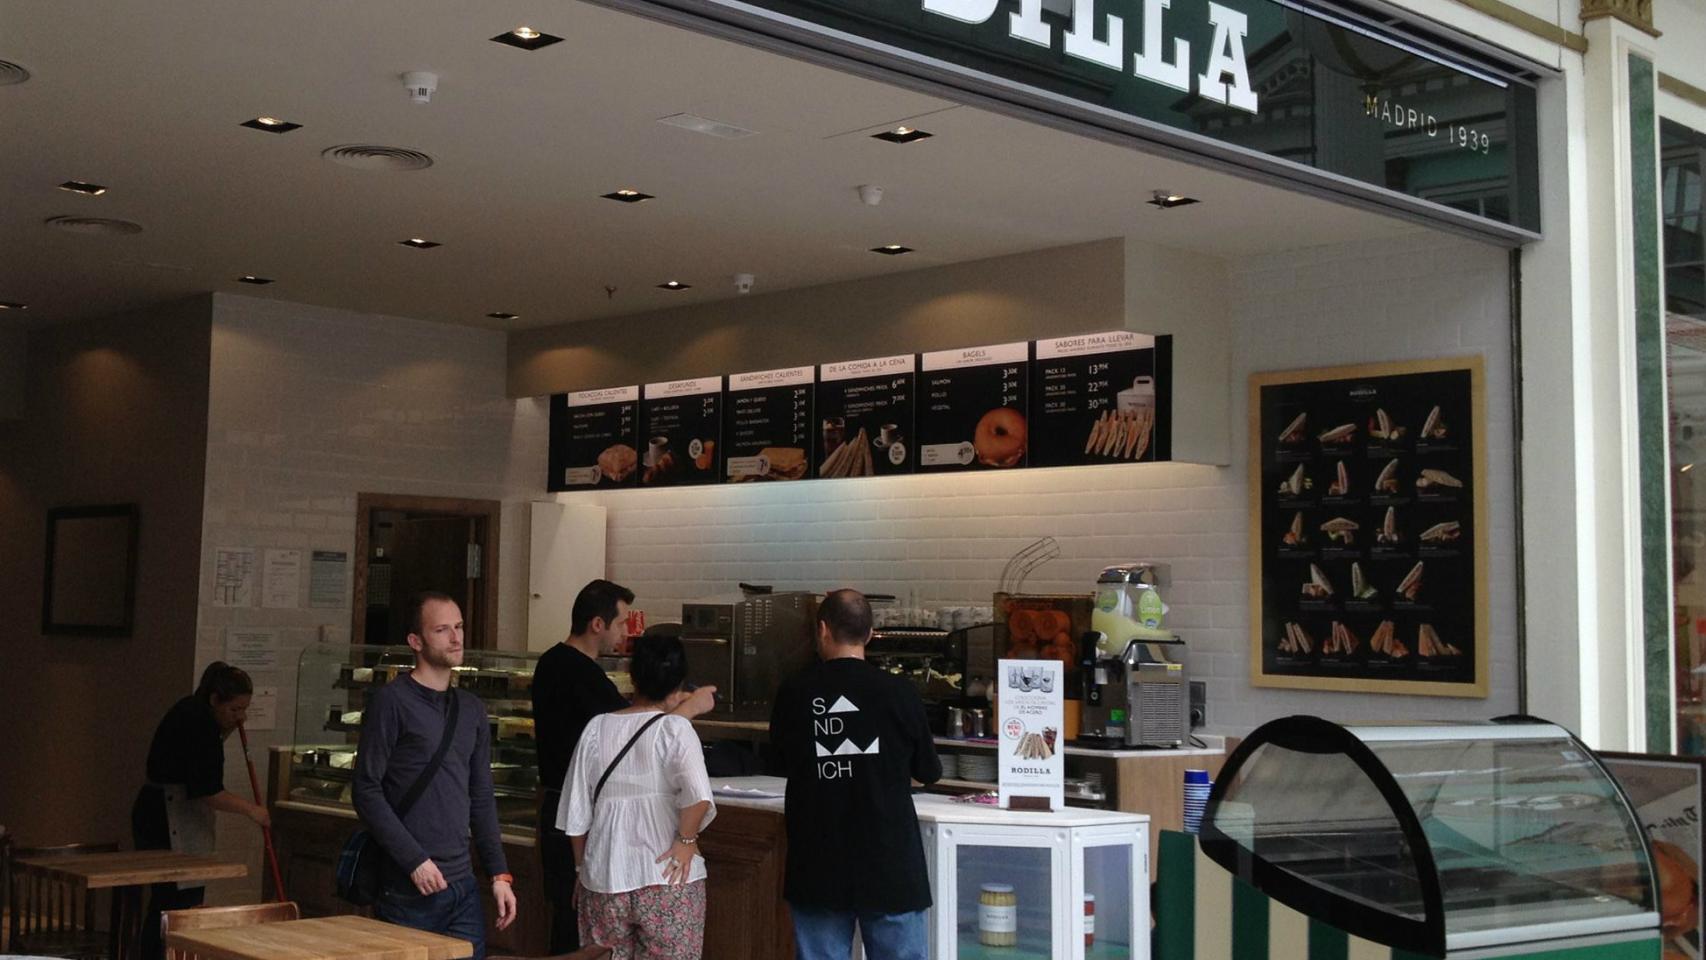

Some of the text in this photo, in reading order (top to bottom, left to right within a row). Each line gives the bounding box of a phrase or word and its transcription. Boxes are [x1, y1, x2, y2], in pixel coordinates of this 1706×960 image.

[1366, 94, 1489, 155] MADRID 1939
[1088, 337, 1105, 345] PARA
[1109, 333, 1135, 343] LLEVAR
[962, 350, 986, 358] BAGELS
[848, 362, 871, 370] COMIDA
[889, 358, 906, 366] CENA
[817, 760, 853, 781] ICH
[1011, 767, 1051, 775] RODILLA
